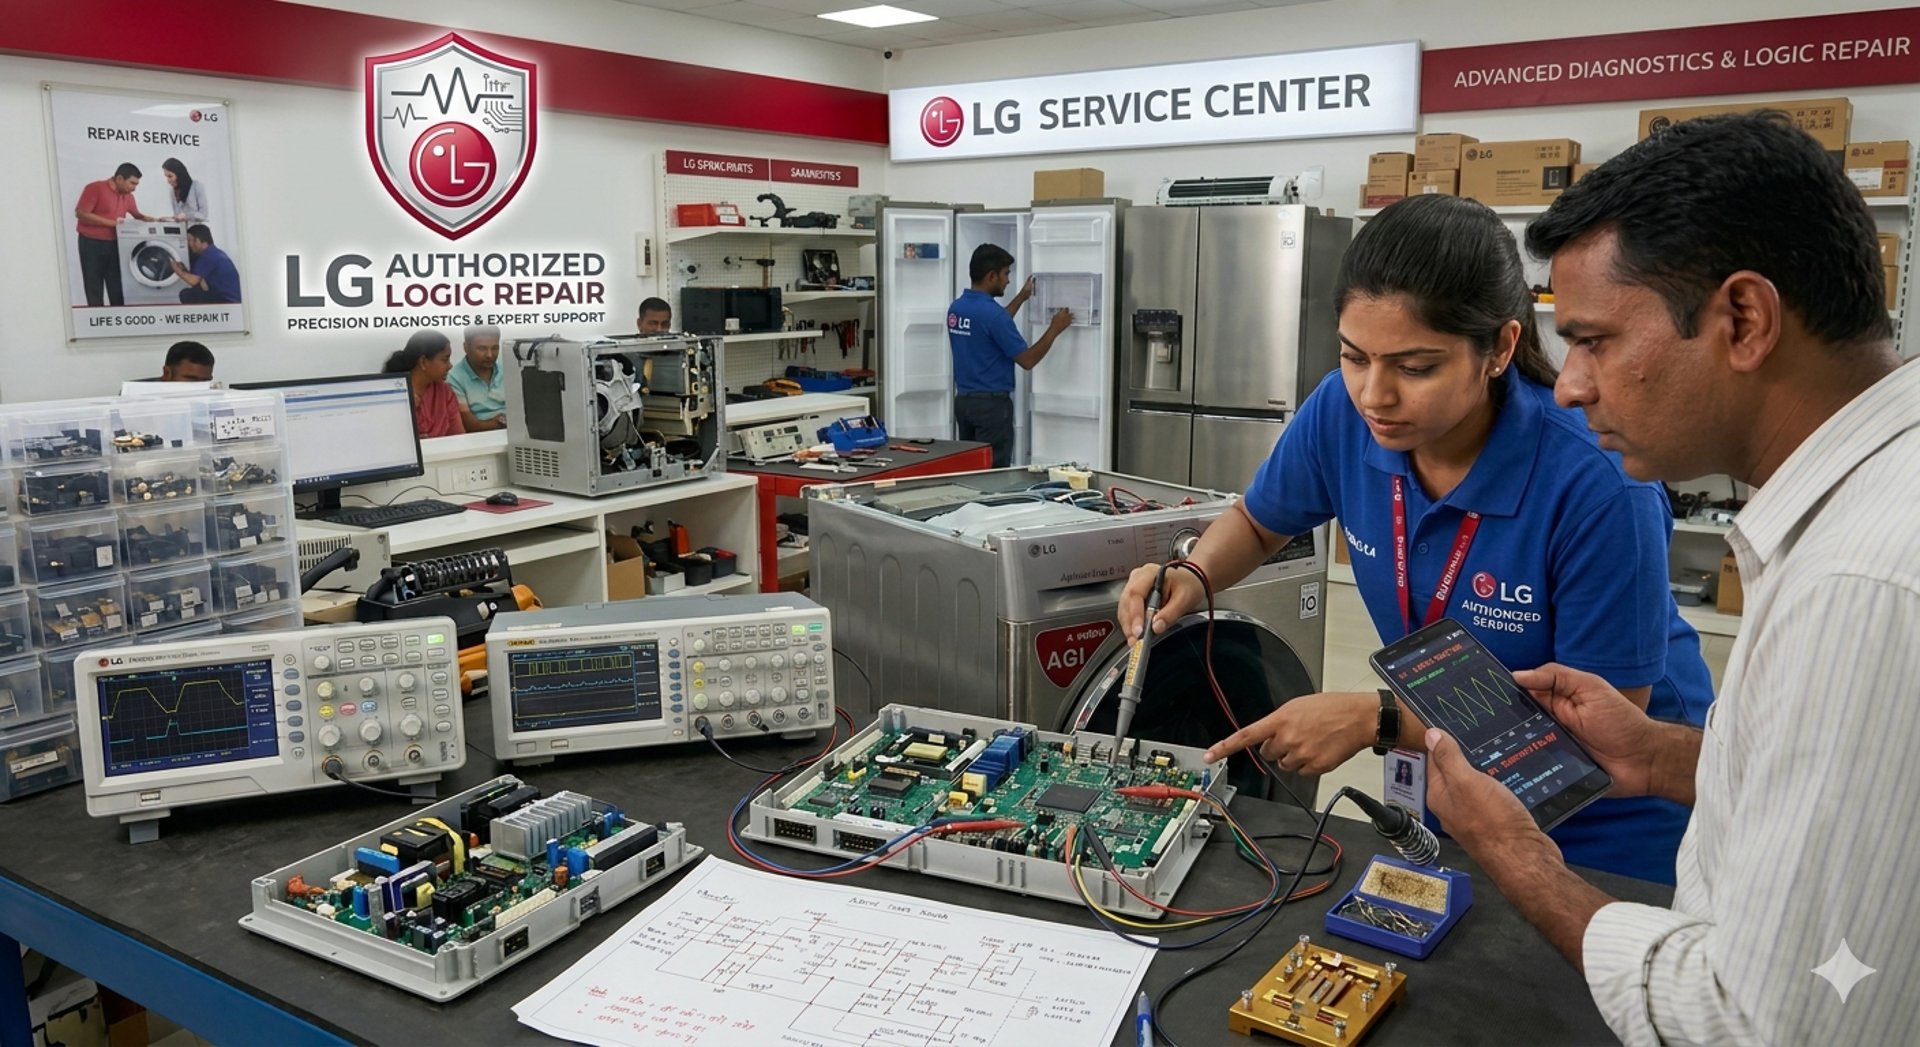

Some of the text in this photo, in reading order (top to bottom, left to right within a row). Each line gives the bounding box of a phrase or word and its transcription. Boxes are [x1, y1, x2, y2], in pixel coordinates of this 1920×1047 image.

[1454, 36, 1911, 88] ADVANCED DIAGNOSTICS & LOGIC REPAIR
[972, 72, 1371, 136] LG SERVICE CENTER
[204, 113, 218, 122] LG
[87, 126, 200, 147] REPAIR SERVICE
[683, 158, 696, 169] LG
[89, 316, 113, 327] LIFE
[115, 316, 122, 326] S
[165, 314, 181, 324] WE
[220, 312, 230, 322] IT
[1042, 543, 1057, 555] LG
[1500, 582, 1533, 604] LG
[1301, 595, 1317, 611] 10
[1046, 647, 1085, 671] AGI
